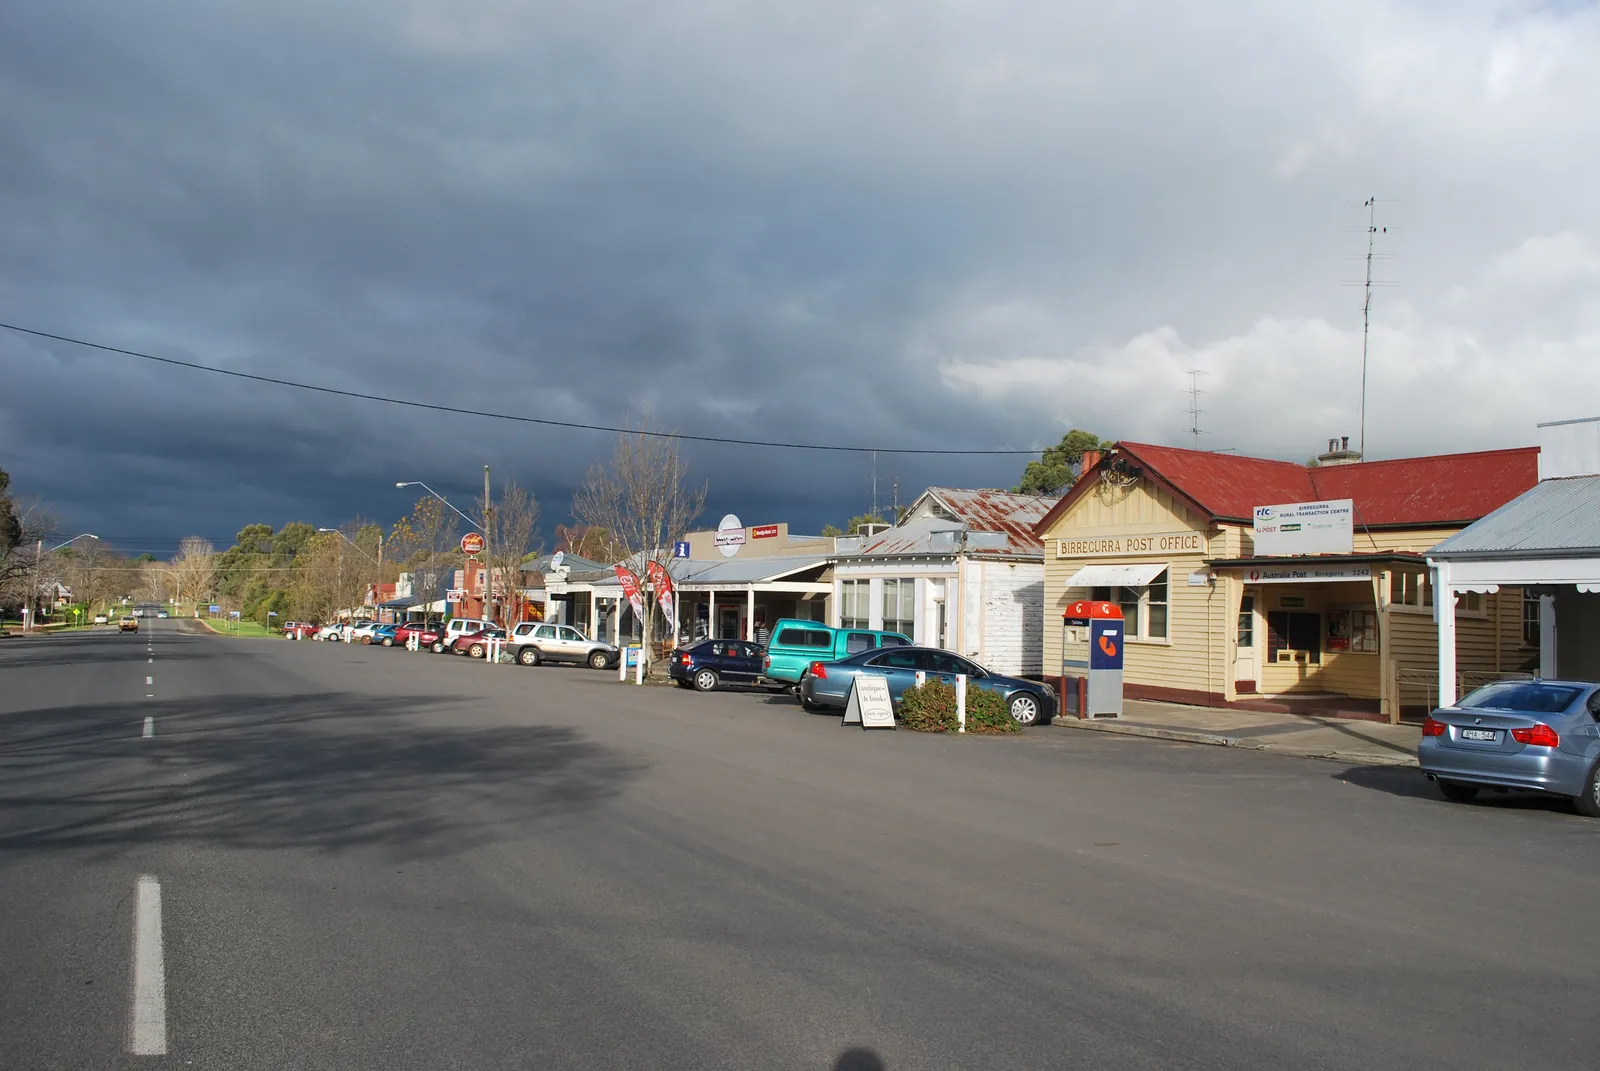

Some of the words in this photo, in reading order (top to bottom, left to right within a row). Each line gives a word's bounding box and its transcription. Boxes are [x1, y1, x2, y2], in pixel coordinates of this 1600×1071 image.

[1061, 540, 1121, 554] BIRREGURRA
[1127, 538, 1154, 551] POST
[1160, 535, 1199, 549] OFFICE
[1262, 571, 1291, 579] Australia
[860, 684, 885, 693] antiques
